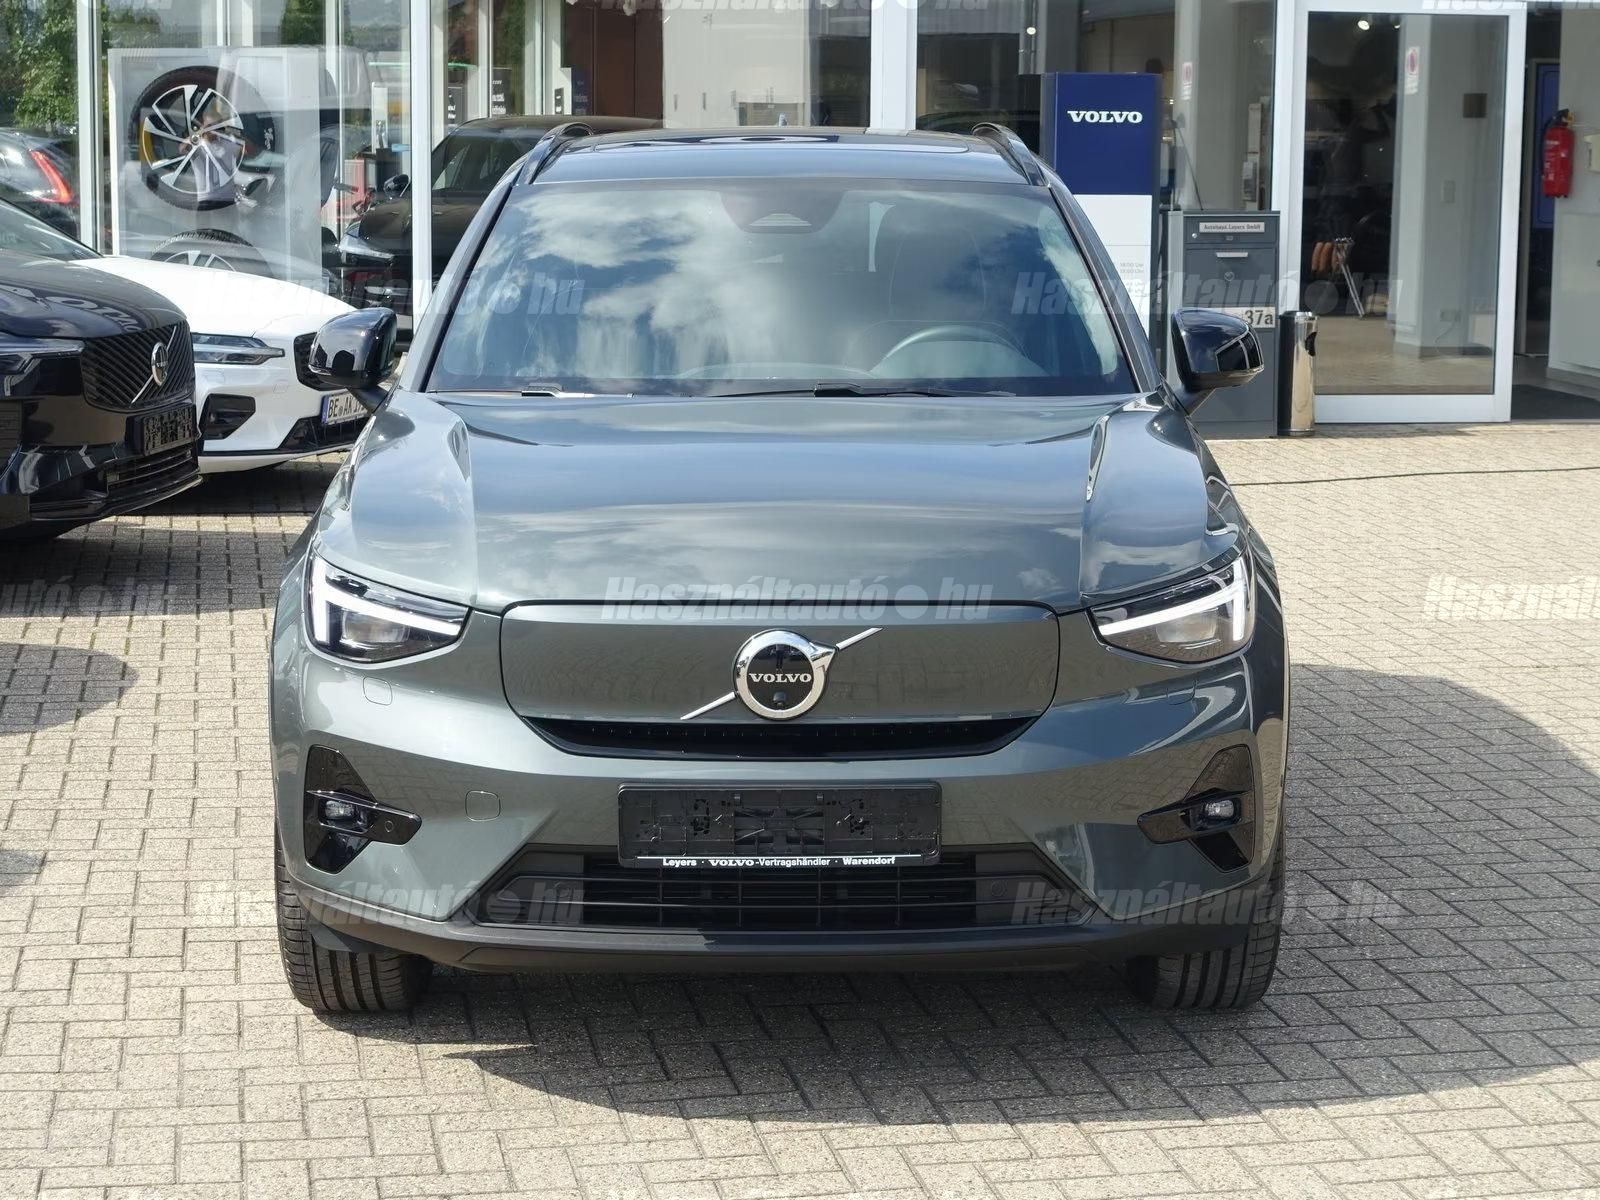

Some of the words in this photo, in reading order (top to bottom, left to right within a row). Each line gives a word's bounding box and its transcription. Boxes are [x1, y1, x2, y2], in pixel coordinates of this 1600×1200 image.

[1067, 111, 1143, 124] VOLVO
[1245, 309, 1273, 325] 37a
[328, 398, 339, 418] BE
[749, 673, 812, 683] VOLVO
[662, 857, 697, 868] Leyers
[842, 856, 896, 866] Warendorf
